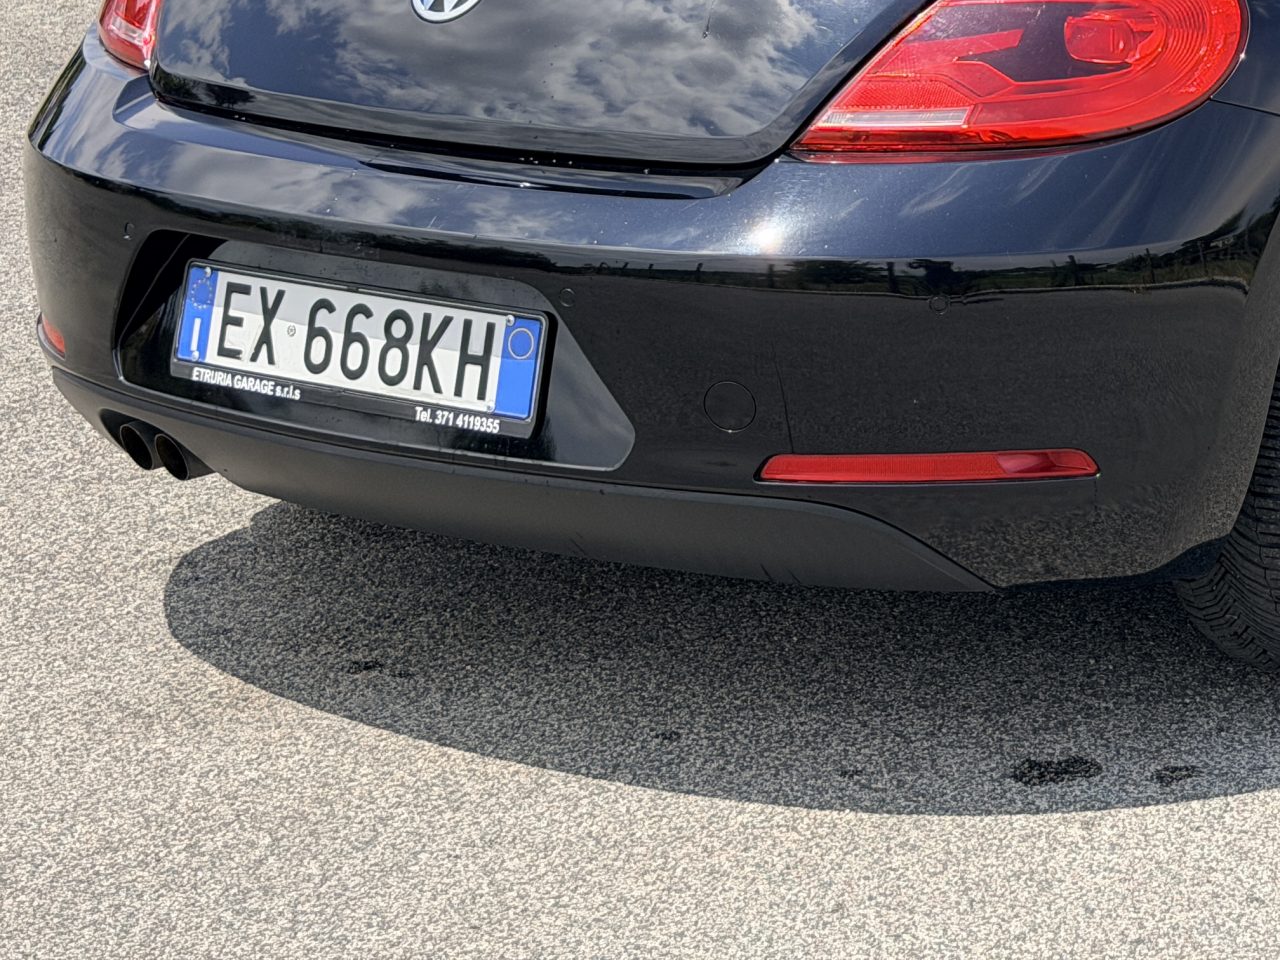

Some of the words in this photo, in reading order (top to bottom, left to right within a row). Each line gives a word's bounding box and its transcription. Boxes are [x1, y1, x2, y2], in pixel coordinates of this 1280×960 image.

[217, 281, 286, 366] EX
[303, 298, 496, 401] 668KH
[192, 367, 232, 388] ETRURIA
[233, 375, 275, 396] GARAGE
[415, 406, 433, 424] Tel.
[434, 410, 454, 427] 371
[455, 413, 500, 434] 4119355
